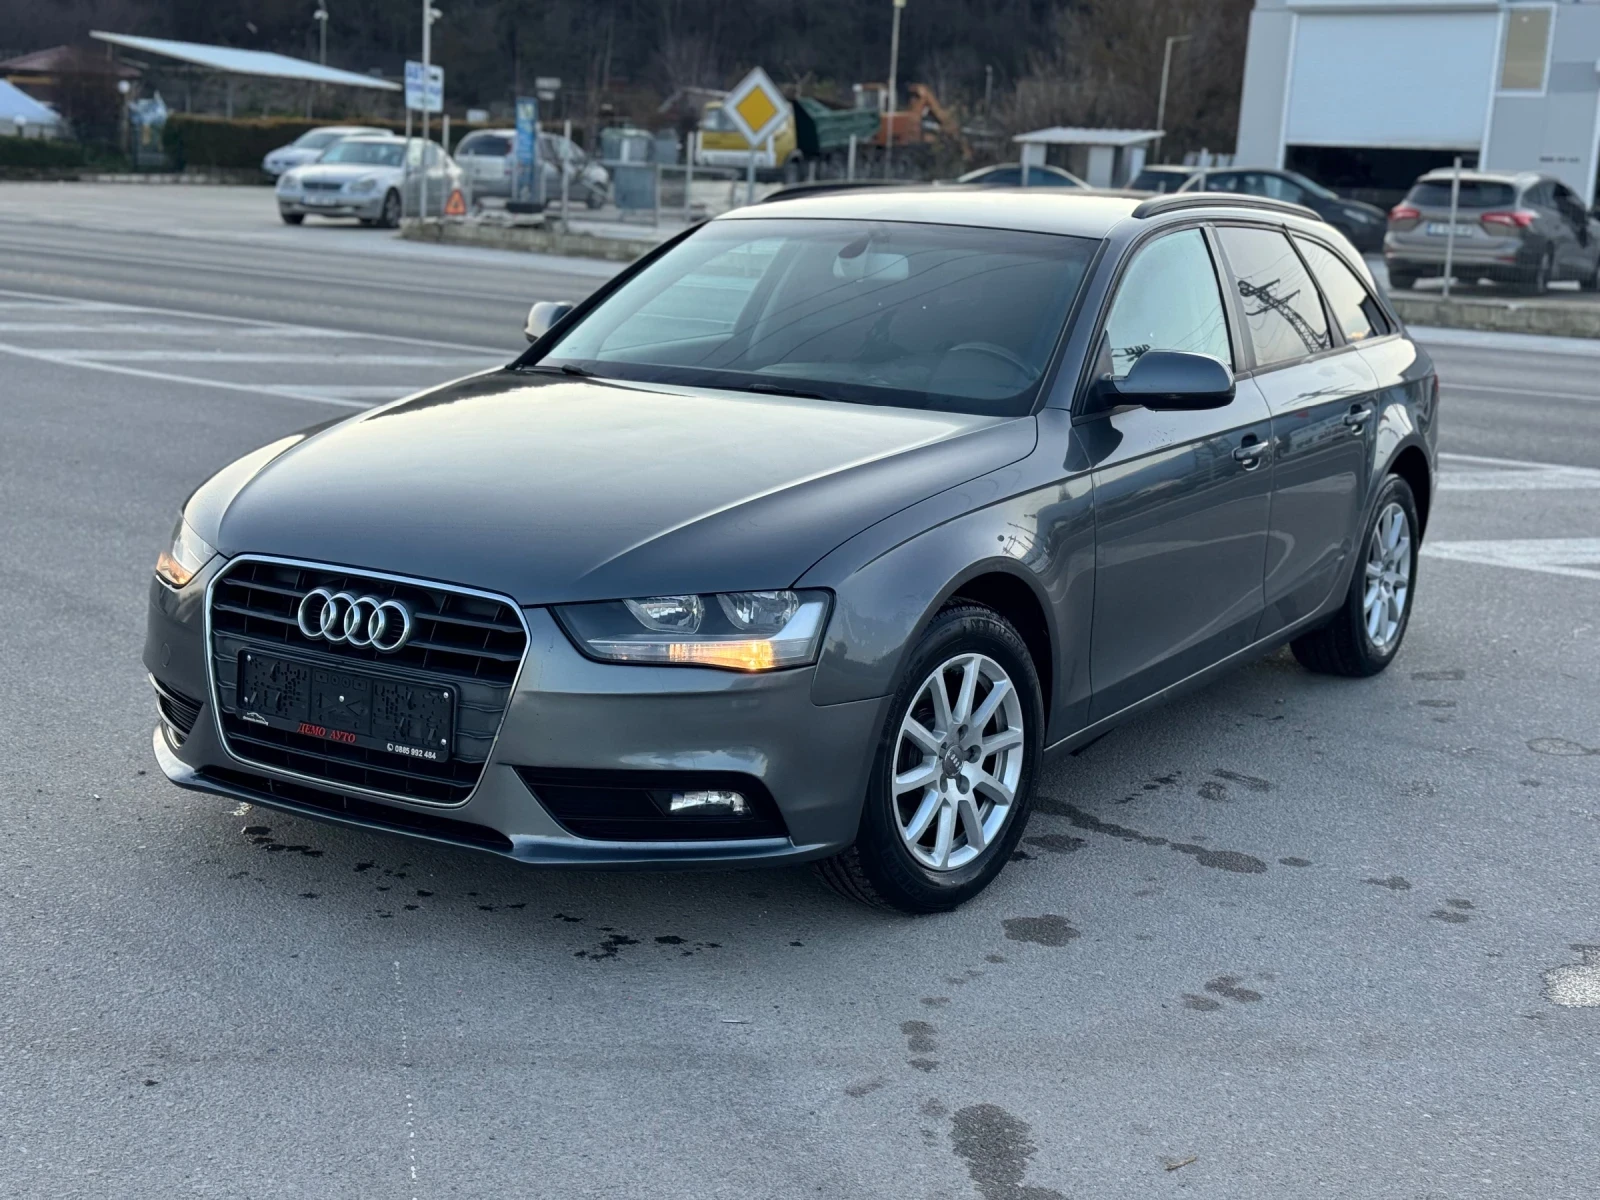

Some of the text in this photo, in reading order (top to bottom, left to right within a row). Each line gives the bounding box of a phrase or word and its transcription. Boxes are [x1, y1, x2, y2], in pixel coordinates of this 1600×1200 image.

[297, 722, 326, 737] ДЕМО
[395, 745, 437, 760] 0885 992 484
